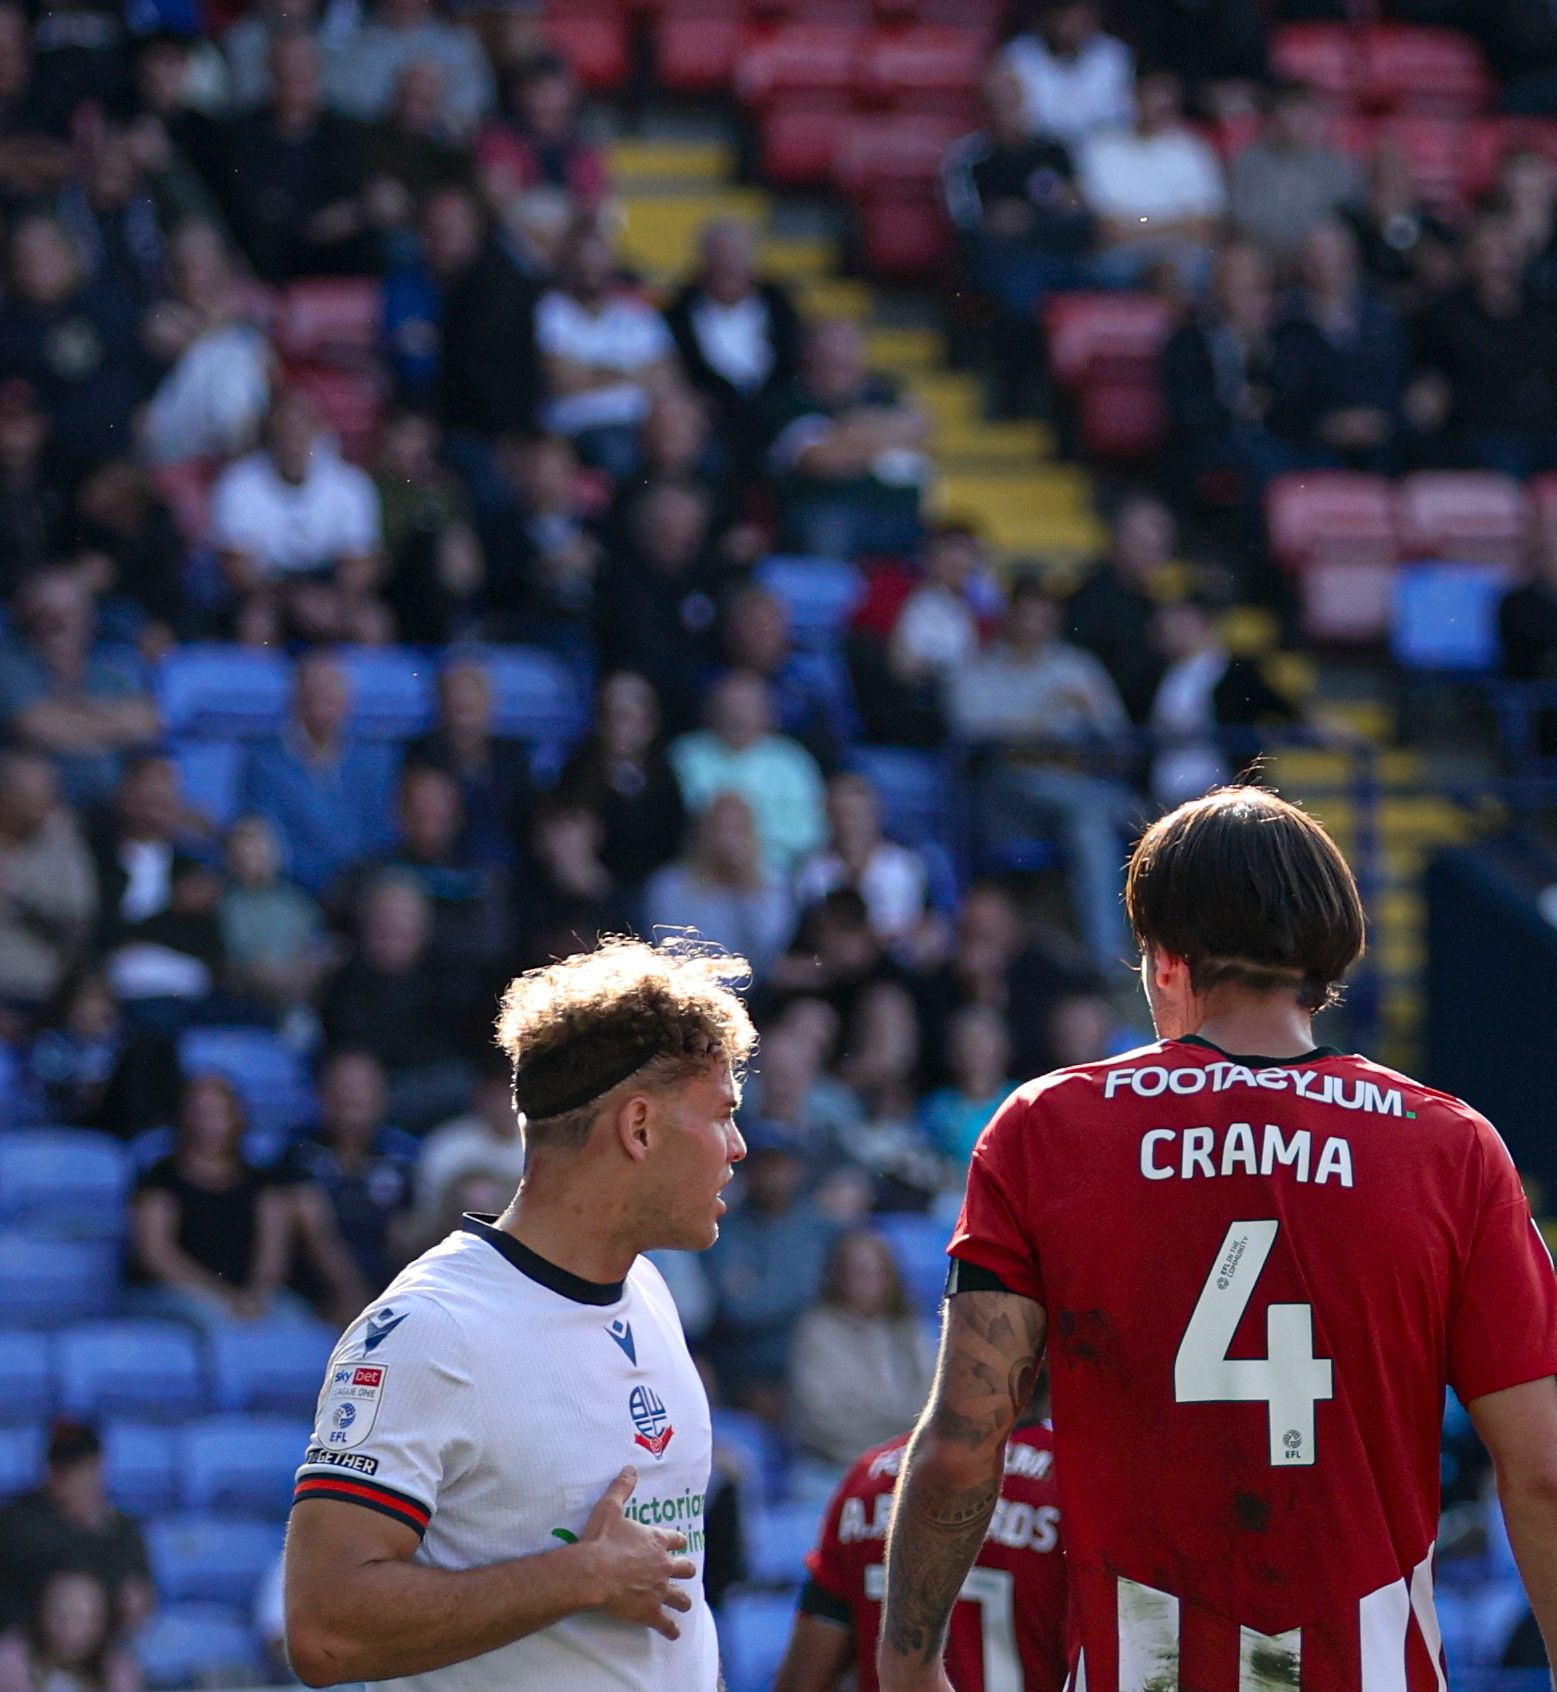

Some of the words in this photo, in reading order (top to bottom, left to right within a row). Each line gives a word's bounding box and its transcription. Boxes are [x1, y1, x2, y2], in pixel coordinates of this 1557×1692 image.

[1139, 1122, 1354, 1188] CRAMA
[1227, 1235, 1248, 1277] COMMUNITY
[1174, 1219, 1333, 1466] 4
[335, 1369, 352, 1384] sky
[356, 1371, 379, 1383] bet
[358, 1388, 376, 1399] ONE
[329, 1431, 347, 1442] EFL
[1285, 1450, 1301, 1459] EFL
